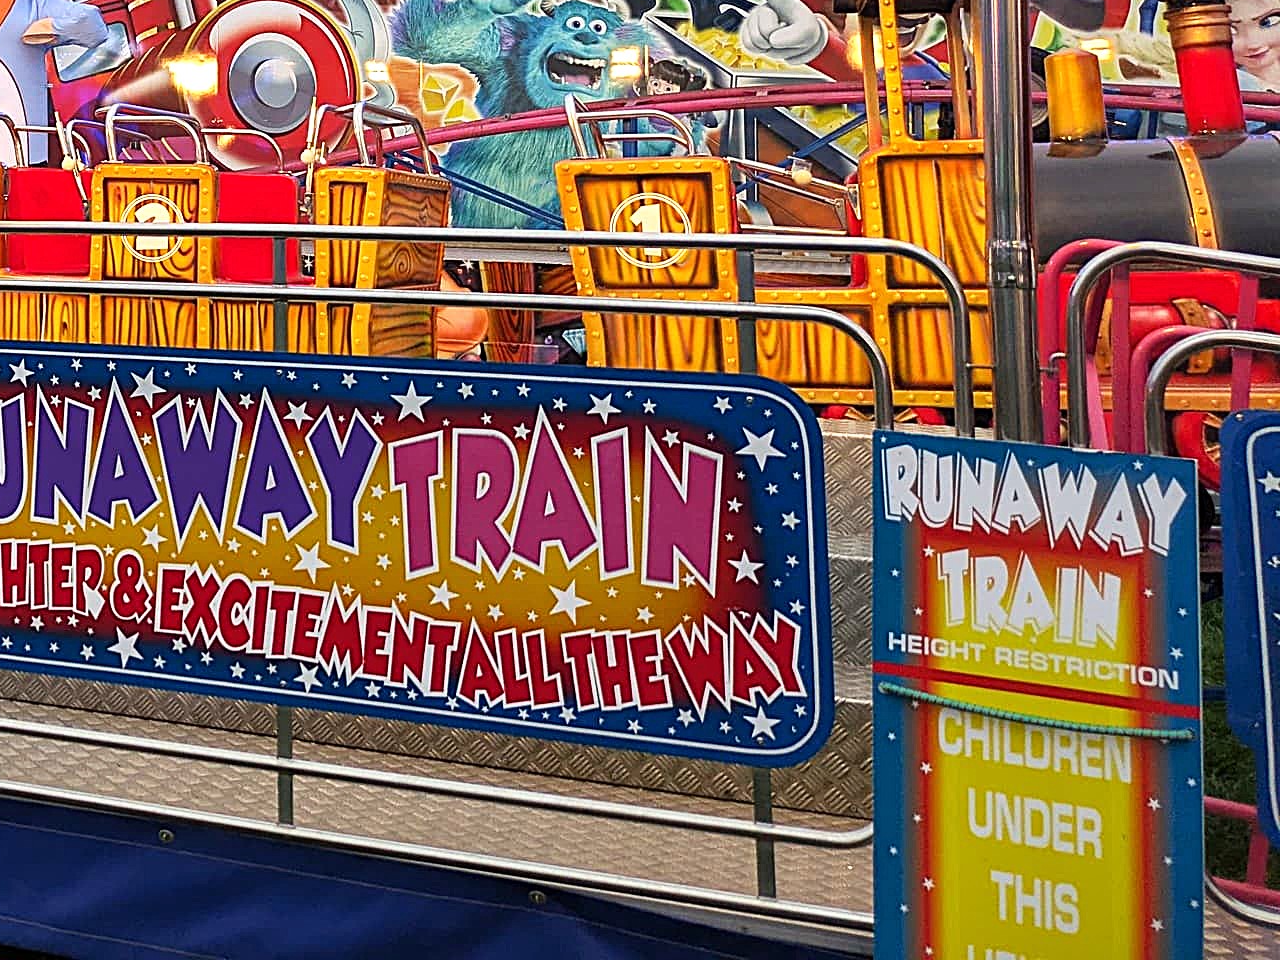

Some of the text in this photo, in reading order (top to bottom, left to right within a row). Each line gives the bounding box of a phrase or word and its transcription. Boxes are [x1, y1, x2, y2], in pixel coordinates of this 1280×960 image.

[134, 202, 170, 250] 2
[629, 204, 662, 256] 1
[387, 404, 723, 599] TRAIN
[881, 444, 1188, 557] RUNAWAY
[110, 548, 153, 624] &
[154, 561, 462, 696] EXCITEMENT
[457, 616, 562, 710] ALL
[560, 628, 675, 712] THE
[664, 609, 808, 724] WAY
[936, 548, 1121, 650] TRAIN
[887, 632, 1179, 690] HEIGHT RESTRICTION
[938, 708, 1133, 784] CHILDREN
[967, 787, 1103, 859] UNDER
[990, 870, 1080, 935] THIS
